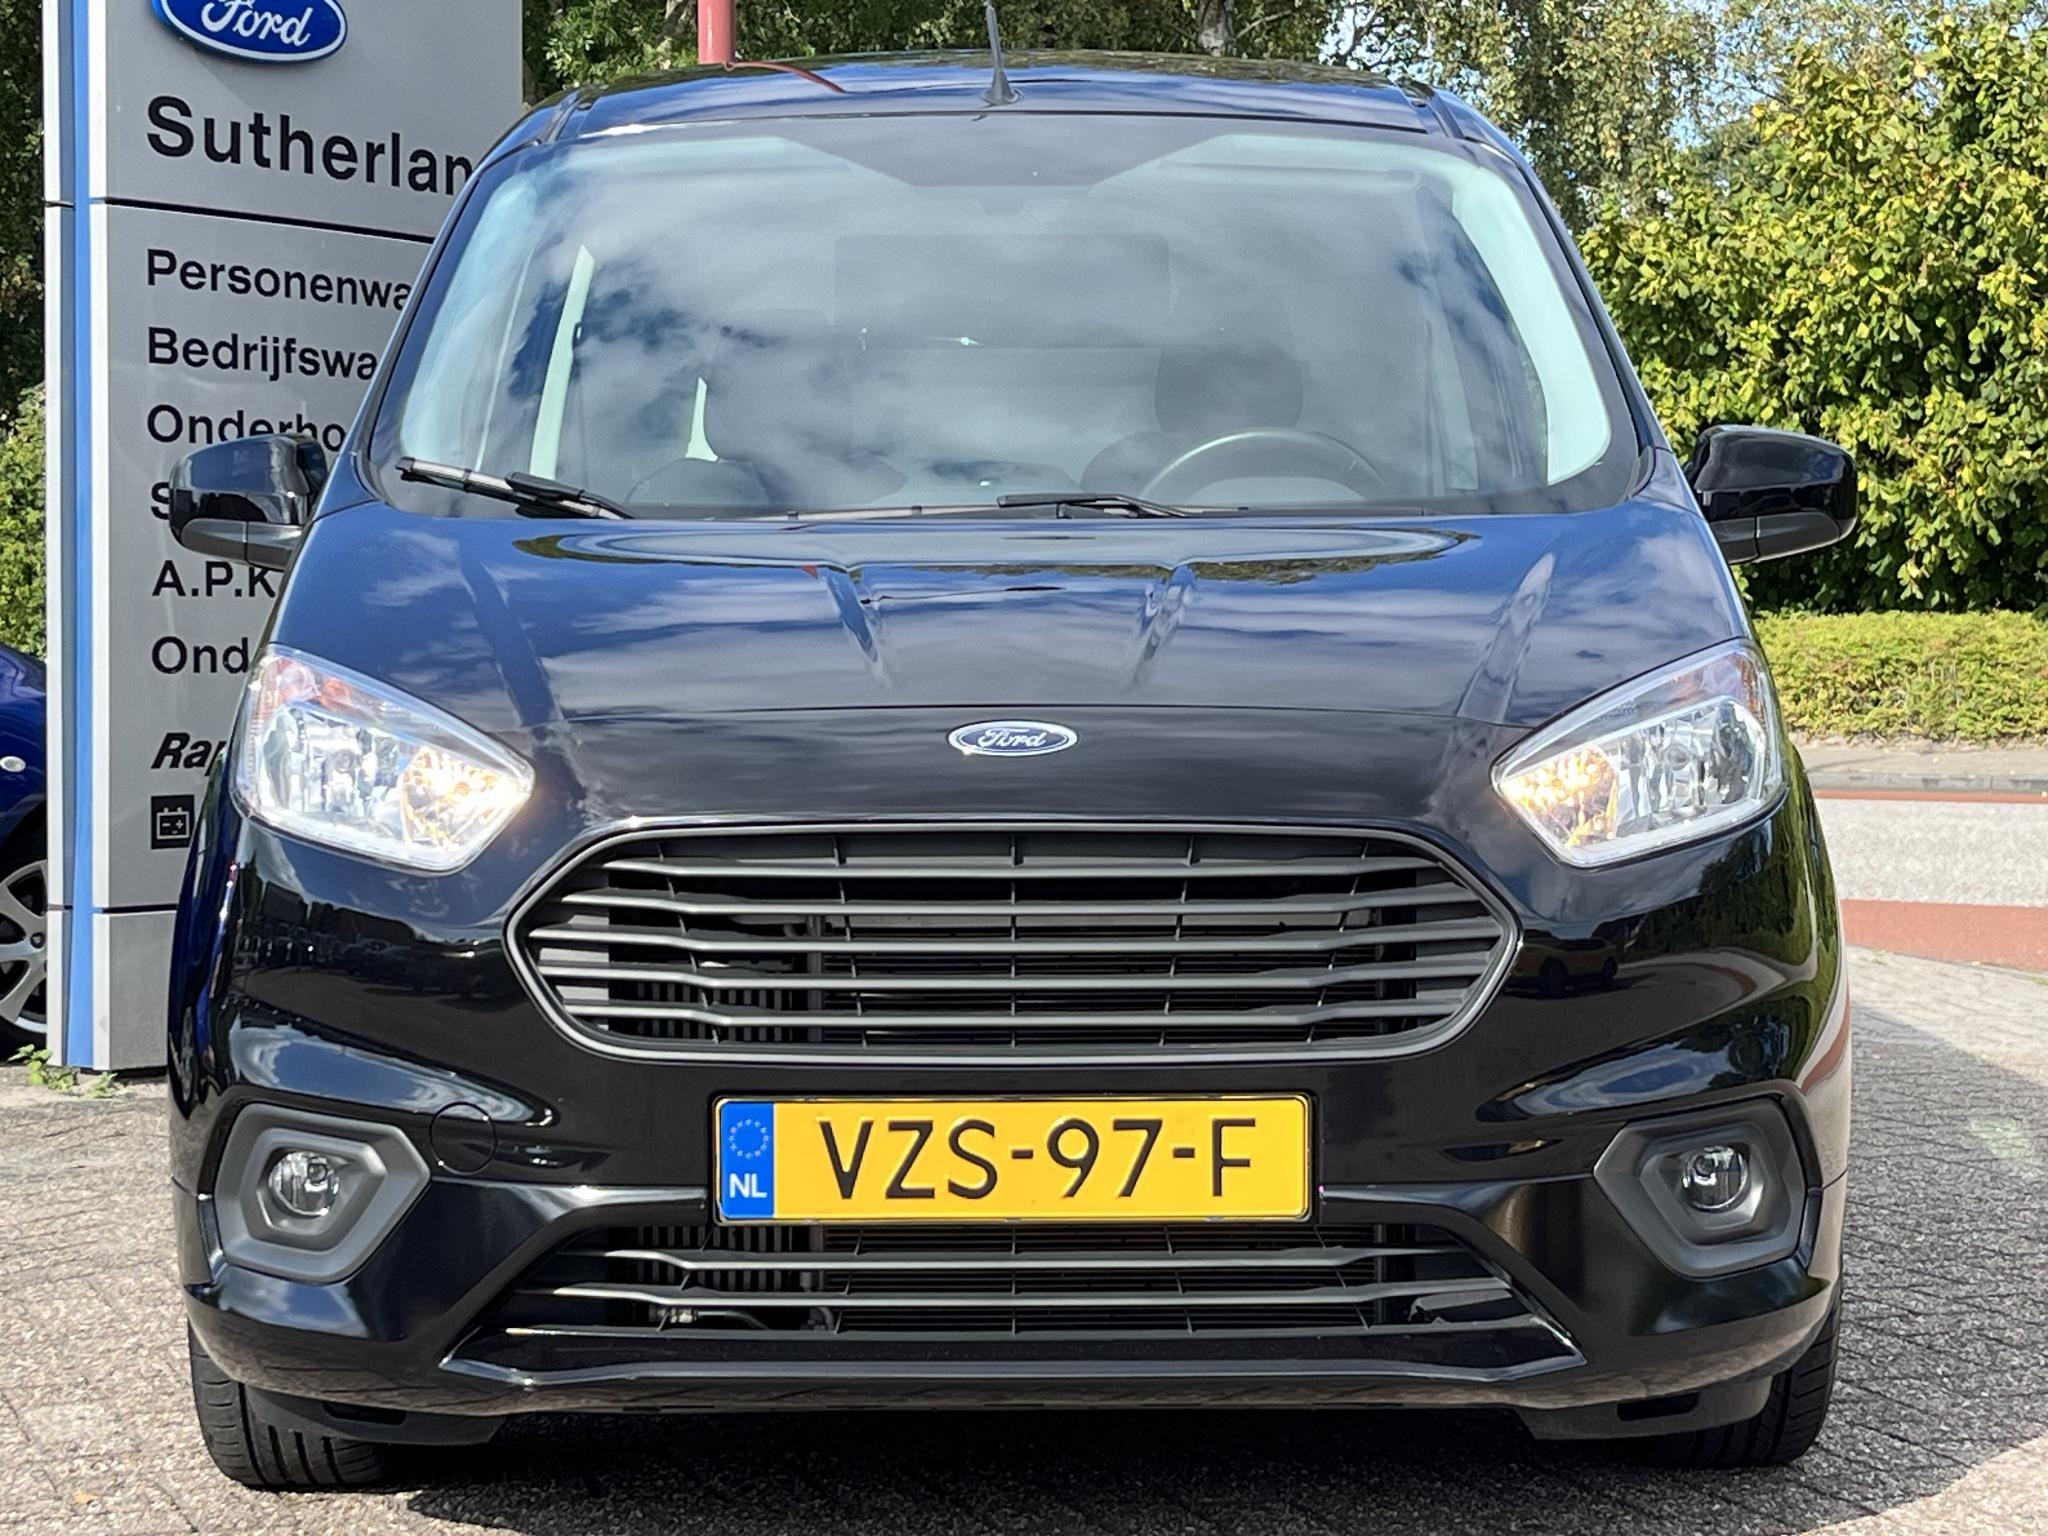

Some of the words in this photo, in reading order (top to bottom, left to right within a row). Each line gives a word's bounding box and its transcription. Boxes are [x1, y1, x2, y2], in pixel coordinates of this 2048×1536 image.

[201, 0, 313, 46] Ford
[147, 96, 474, 196] Sutherlan
[147, 249, 412, 310] Personenwa
[148, 328, 378, 382] Bedrijfswa
[152, 560, 276, 598] A.P.K
[152, 636, 249, 674] Ond
[977, 728, 1047, 747] Ford
[820, 1118, 1256, 1199] VZS-97-F
[729, 1173, 767, 1197] NL
